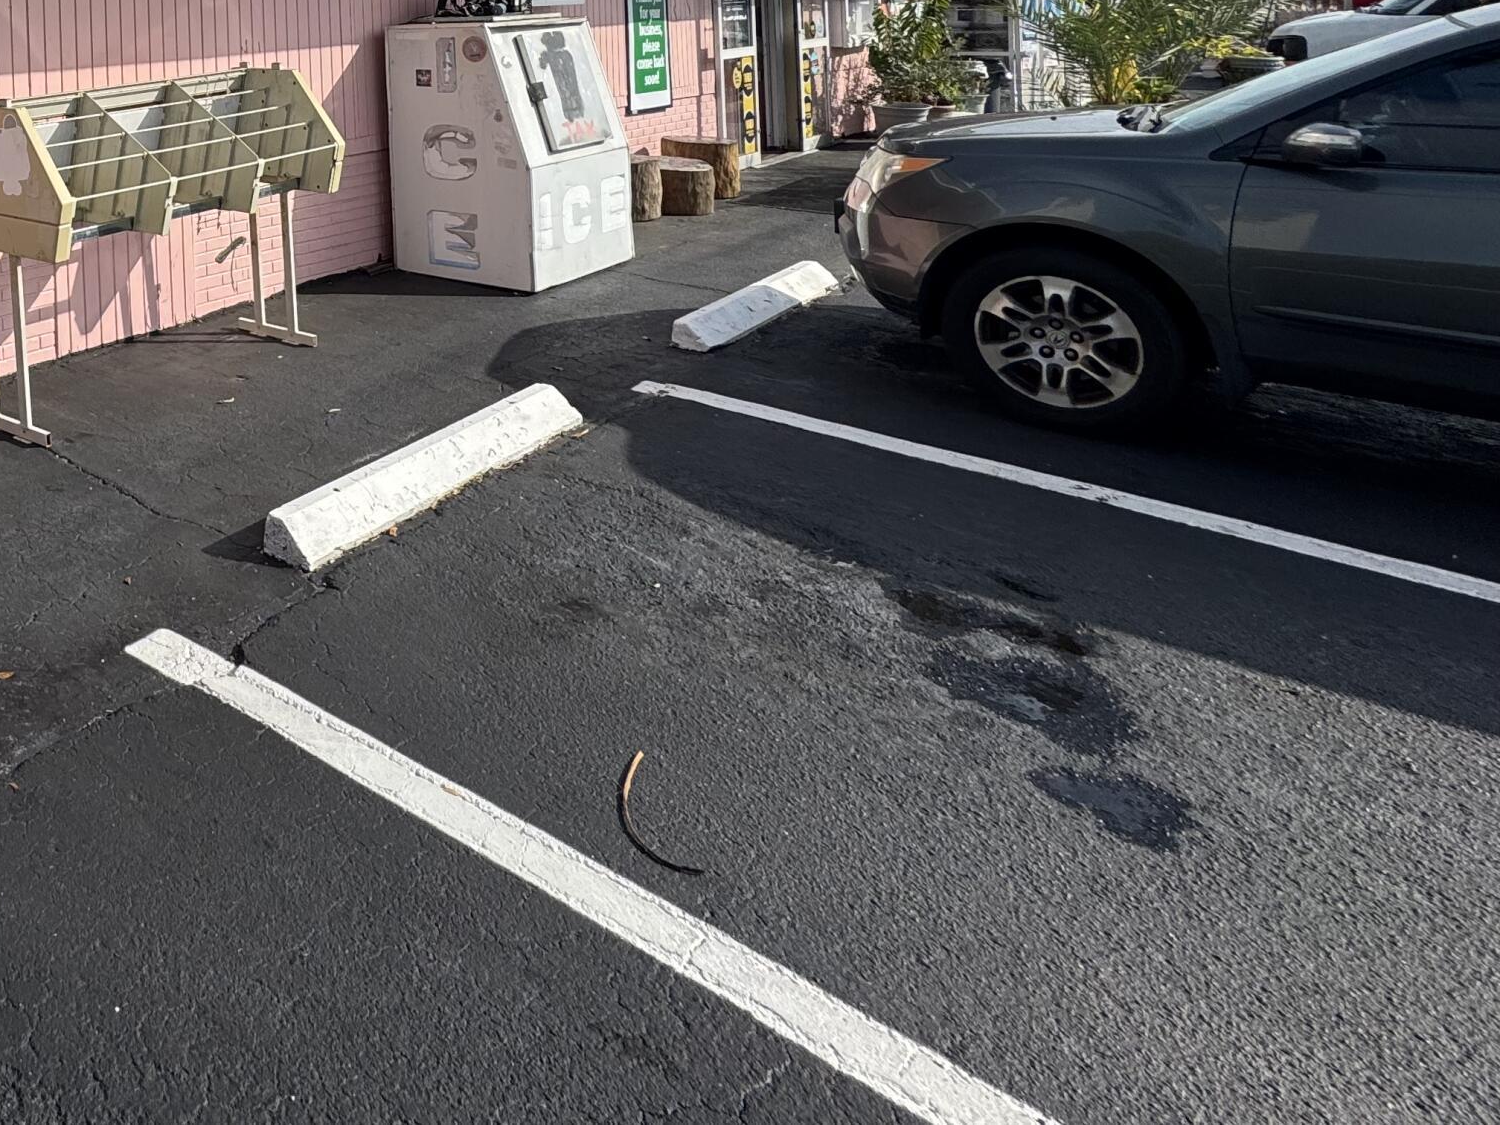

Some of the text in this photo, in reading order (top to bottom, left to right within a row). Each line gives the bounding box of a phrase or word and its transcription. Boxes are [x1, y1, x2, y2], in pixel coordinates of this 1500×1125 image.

[639, 7, 661, 24] for your
[642, 39, 660, 56] please
[636, 55, 665, 70] come back
[644, 71, 660, 86] soon!
[538, 174, 627, 252] ICE
